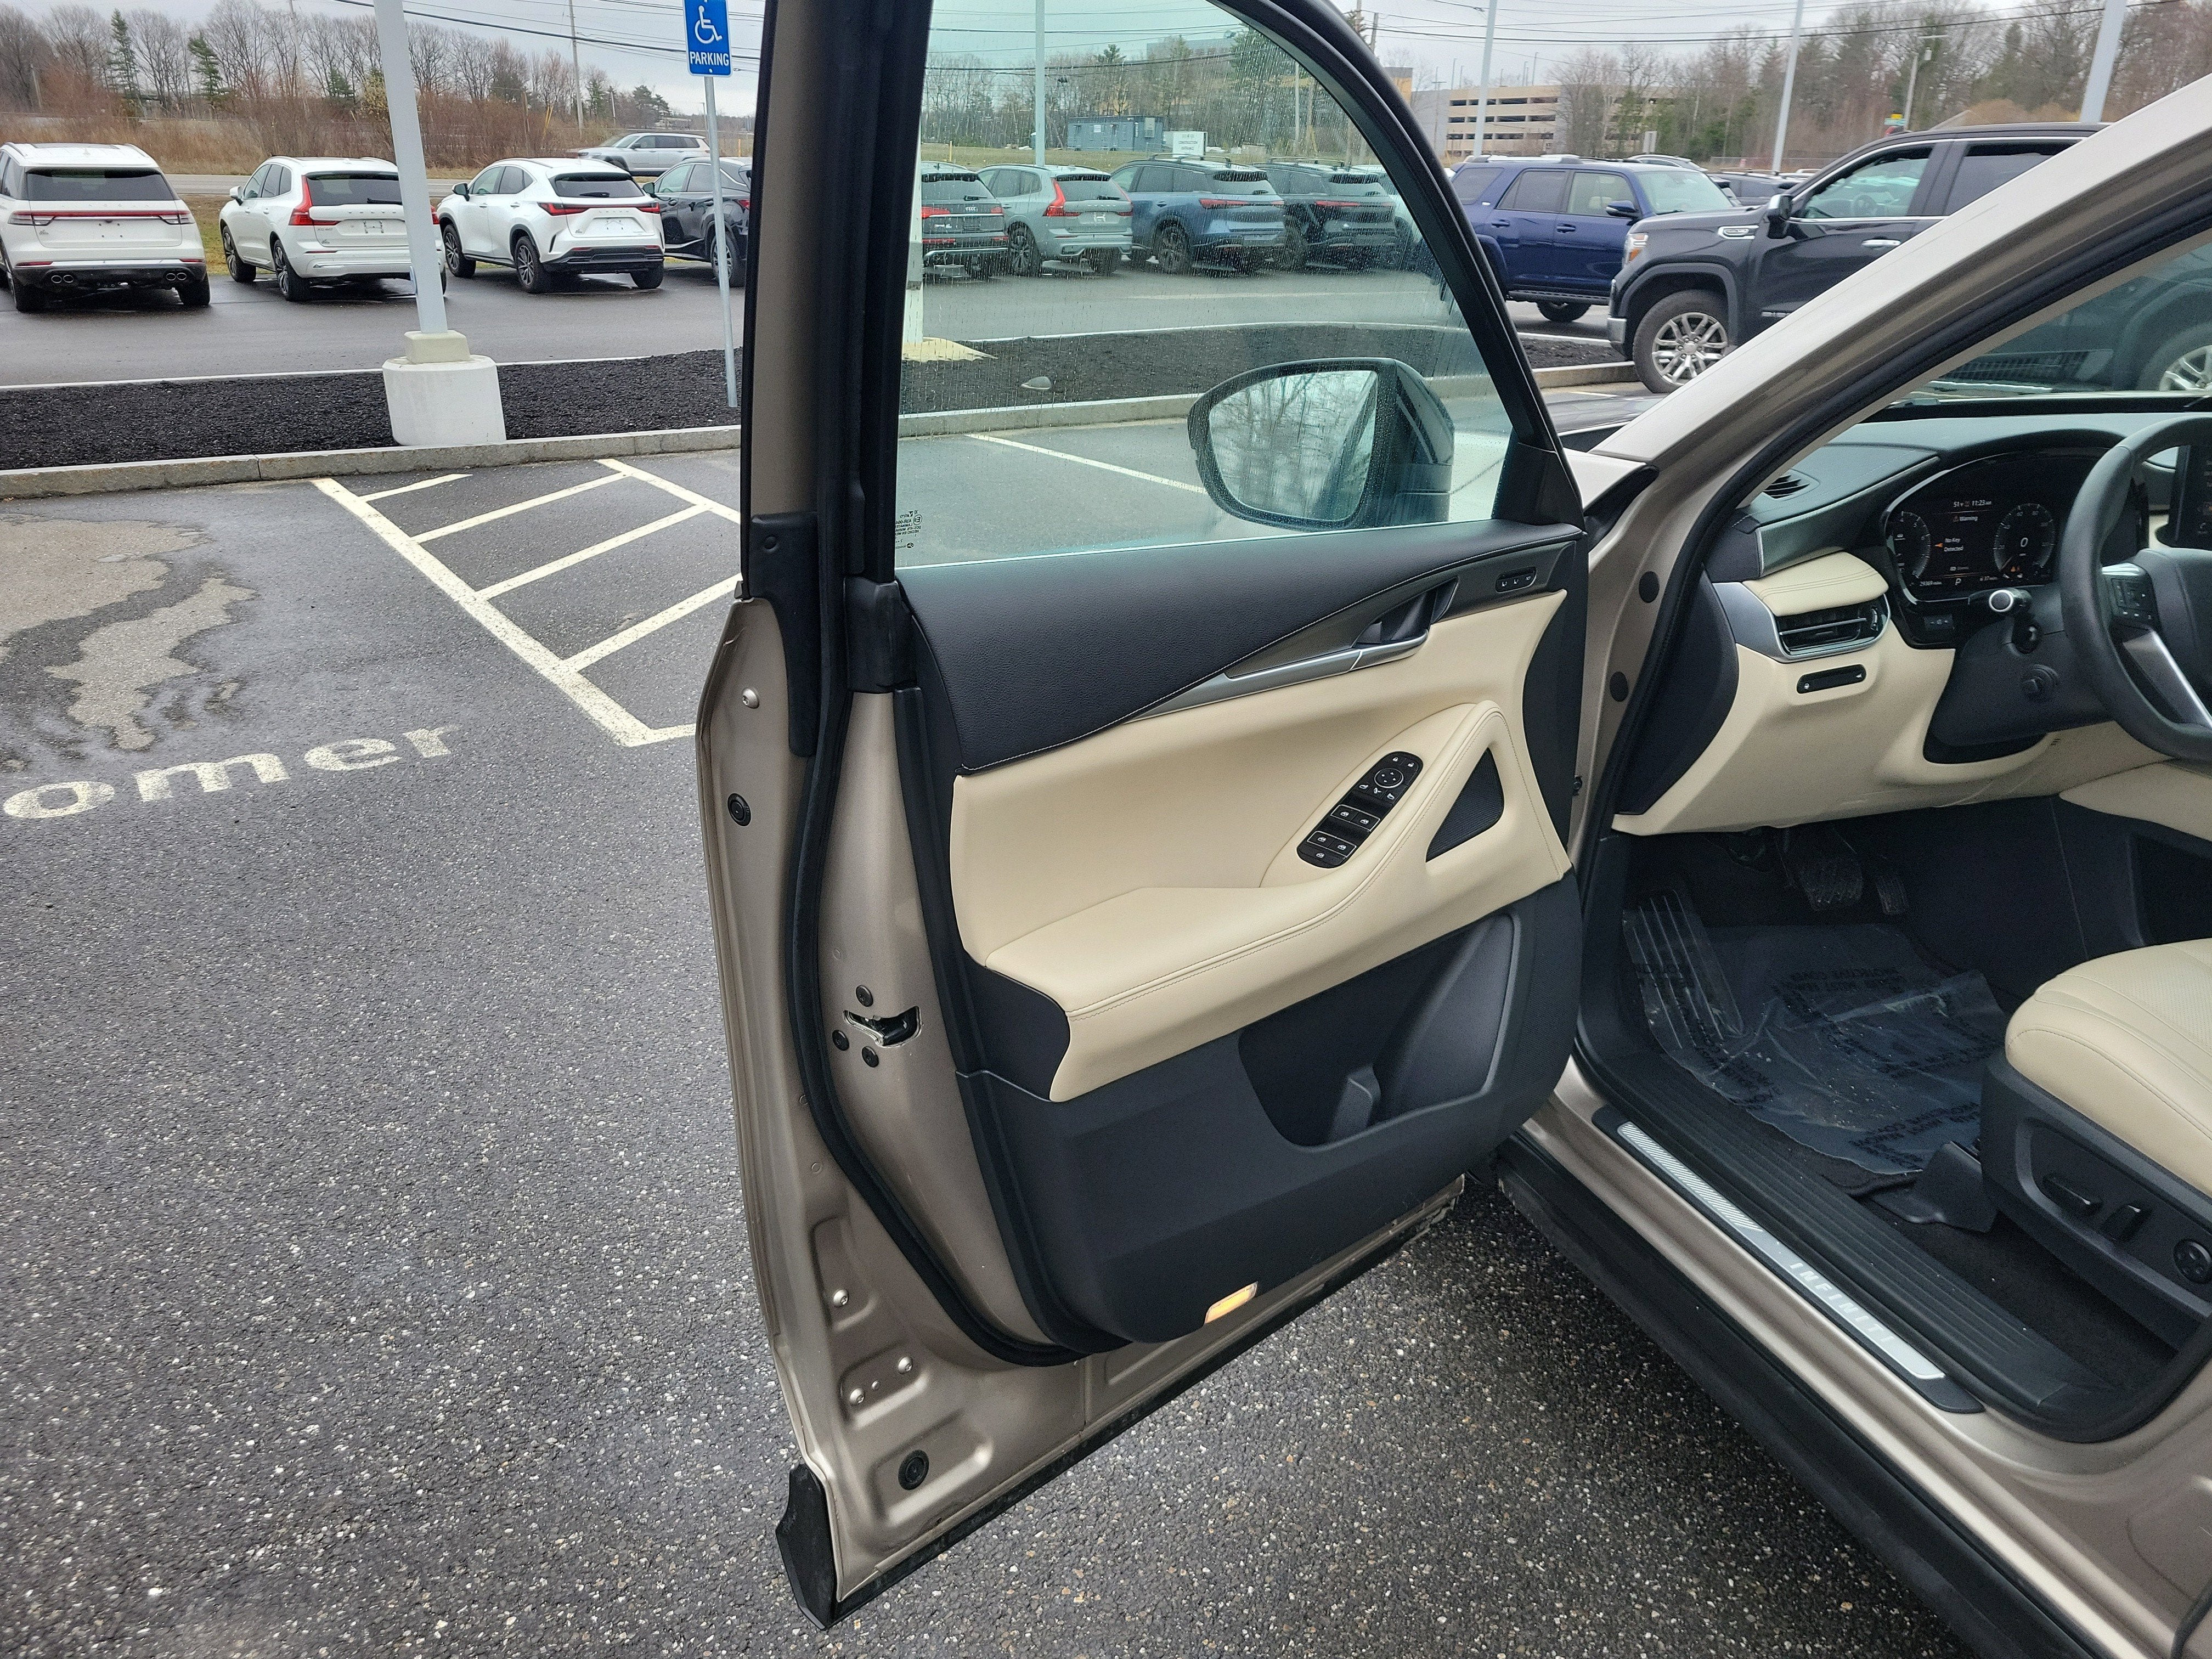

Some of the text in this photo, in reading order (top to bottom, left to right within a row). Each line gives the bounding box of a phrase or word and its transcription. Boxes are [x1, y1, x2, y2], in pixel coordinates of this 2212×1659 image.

[690, 51, 730, 66] PARKING
[2020, 537, 2029, 548] 0
[3, 724, 461, 819] omer
